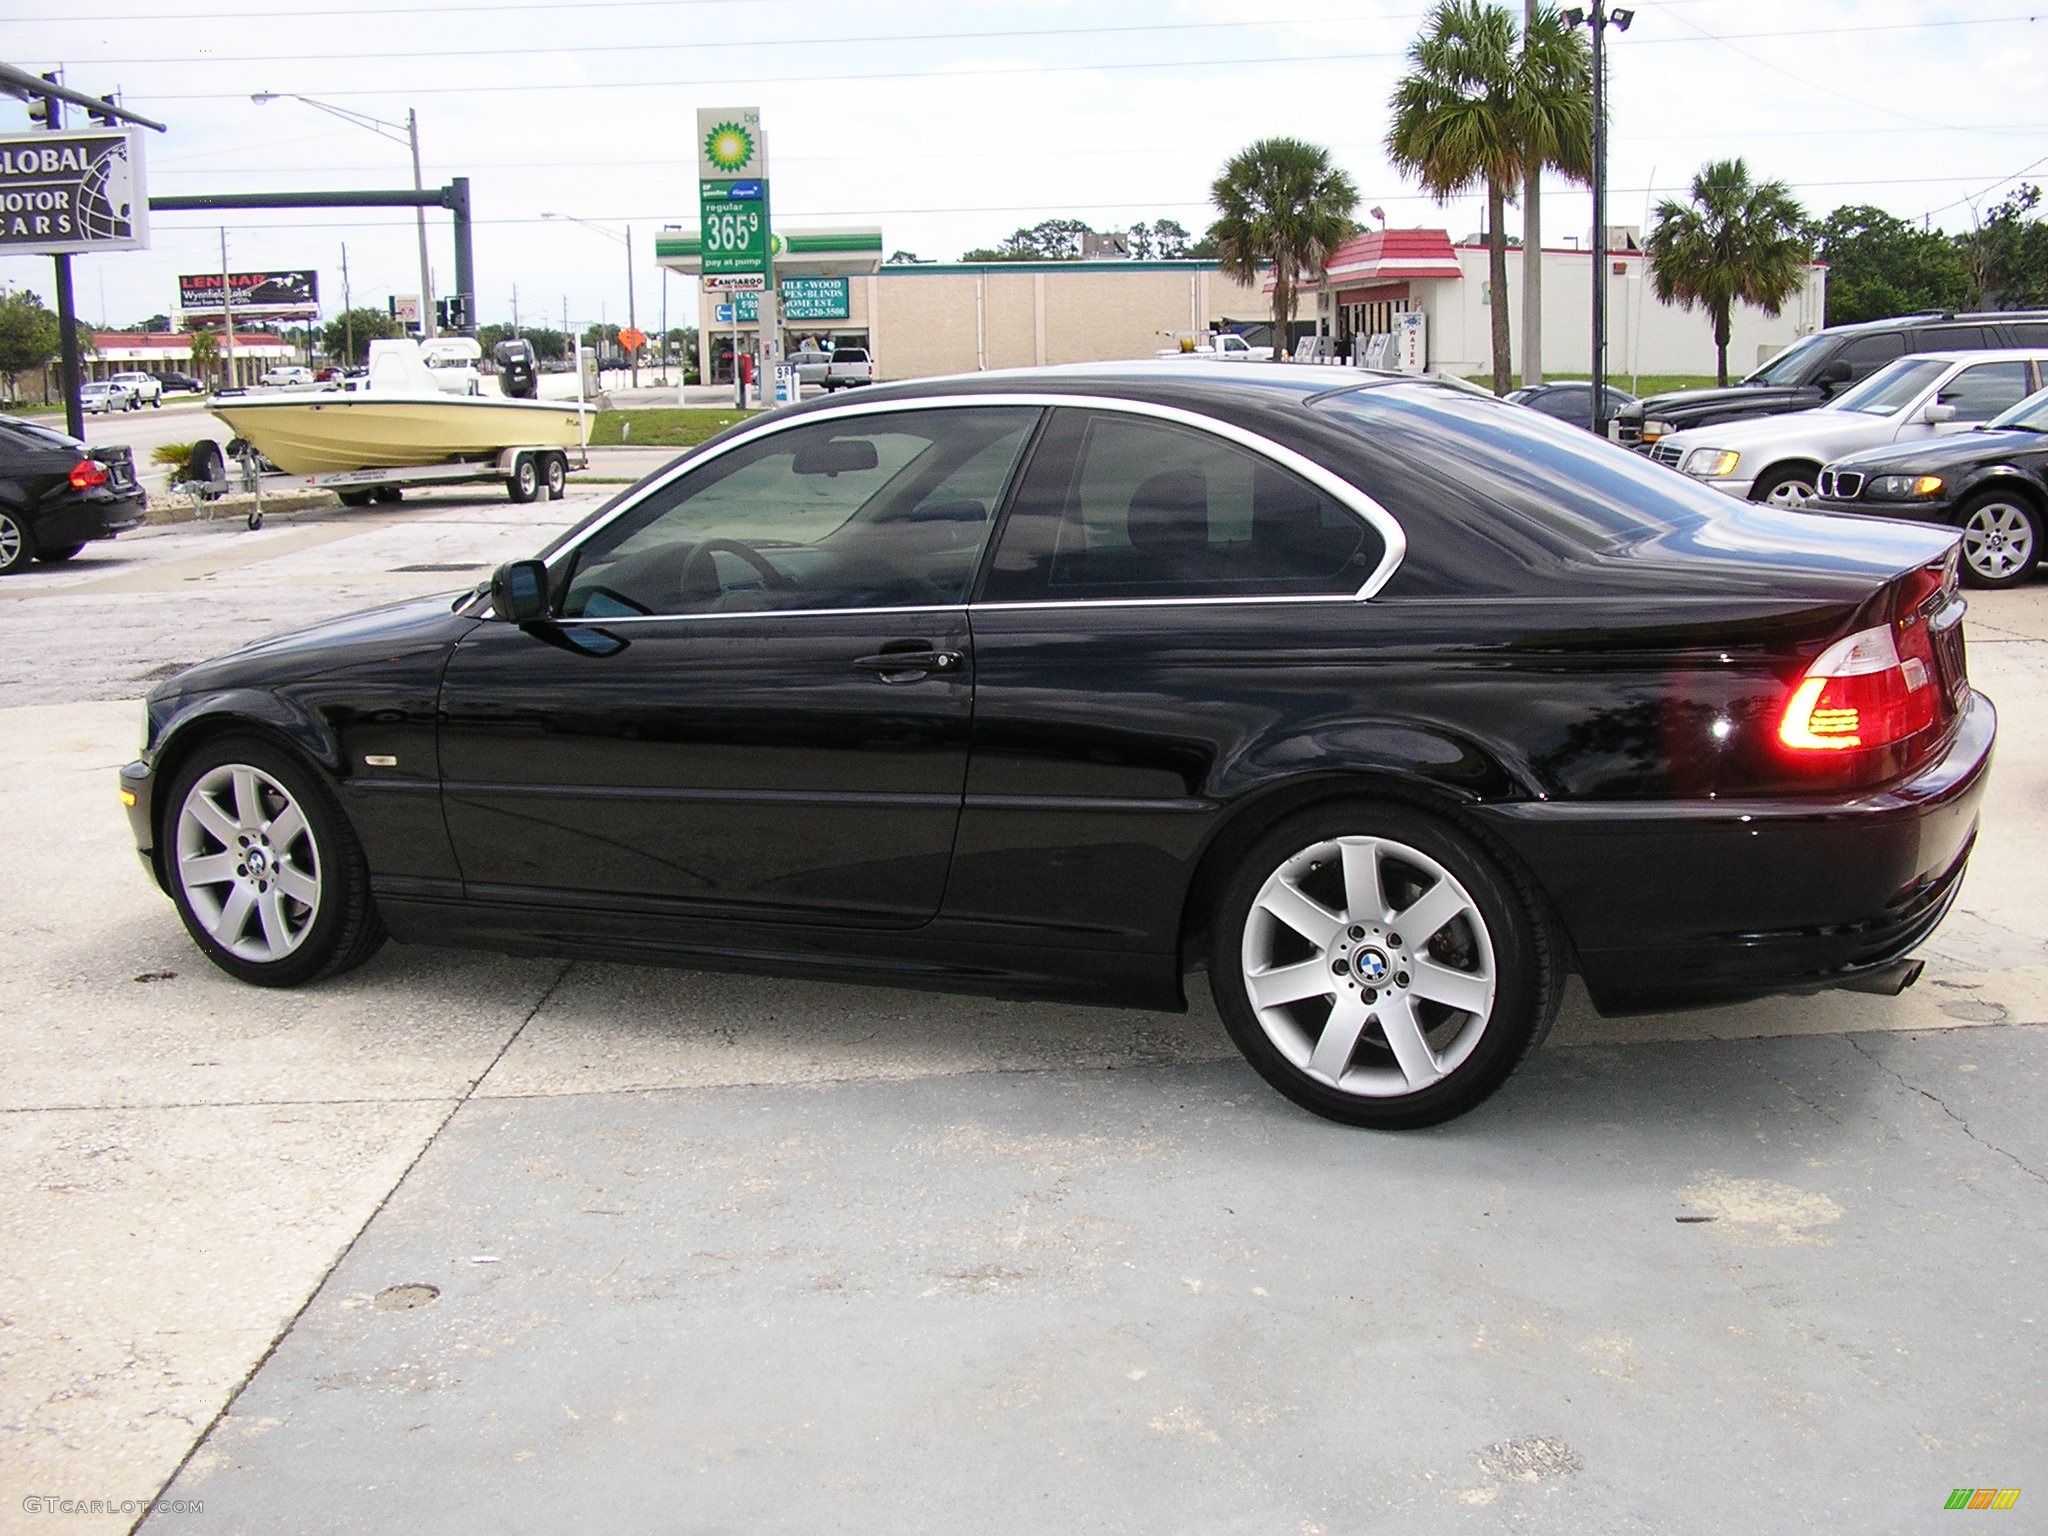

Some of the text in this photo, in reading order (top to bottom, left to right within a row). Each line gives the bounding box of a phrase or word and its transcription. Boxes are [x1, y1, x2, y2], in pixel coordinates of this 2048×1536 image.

[744, 112, 759, 124] bp
[706, 203, 743, 212] regular
[735, 259, 761, 267] pump
[181, 274, 267, 289] LENNAR
[809, 280, 841, 289] WOOD
